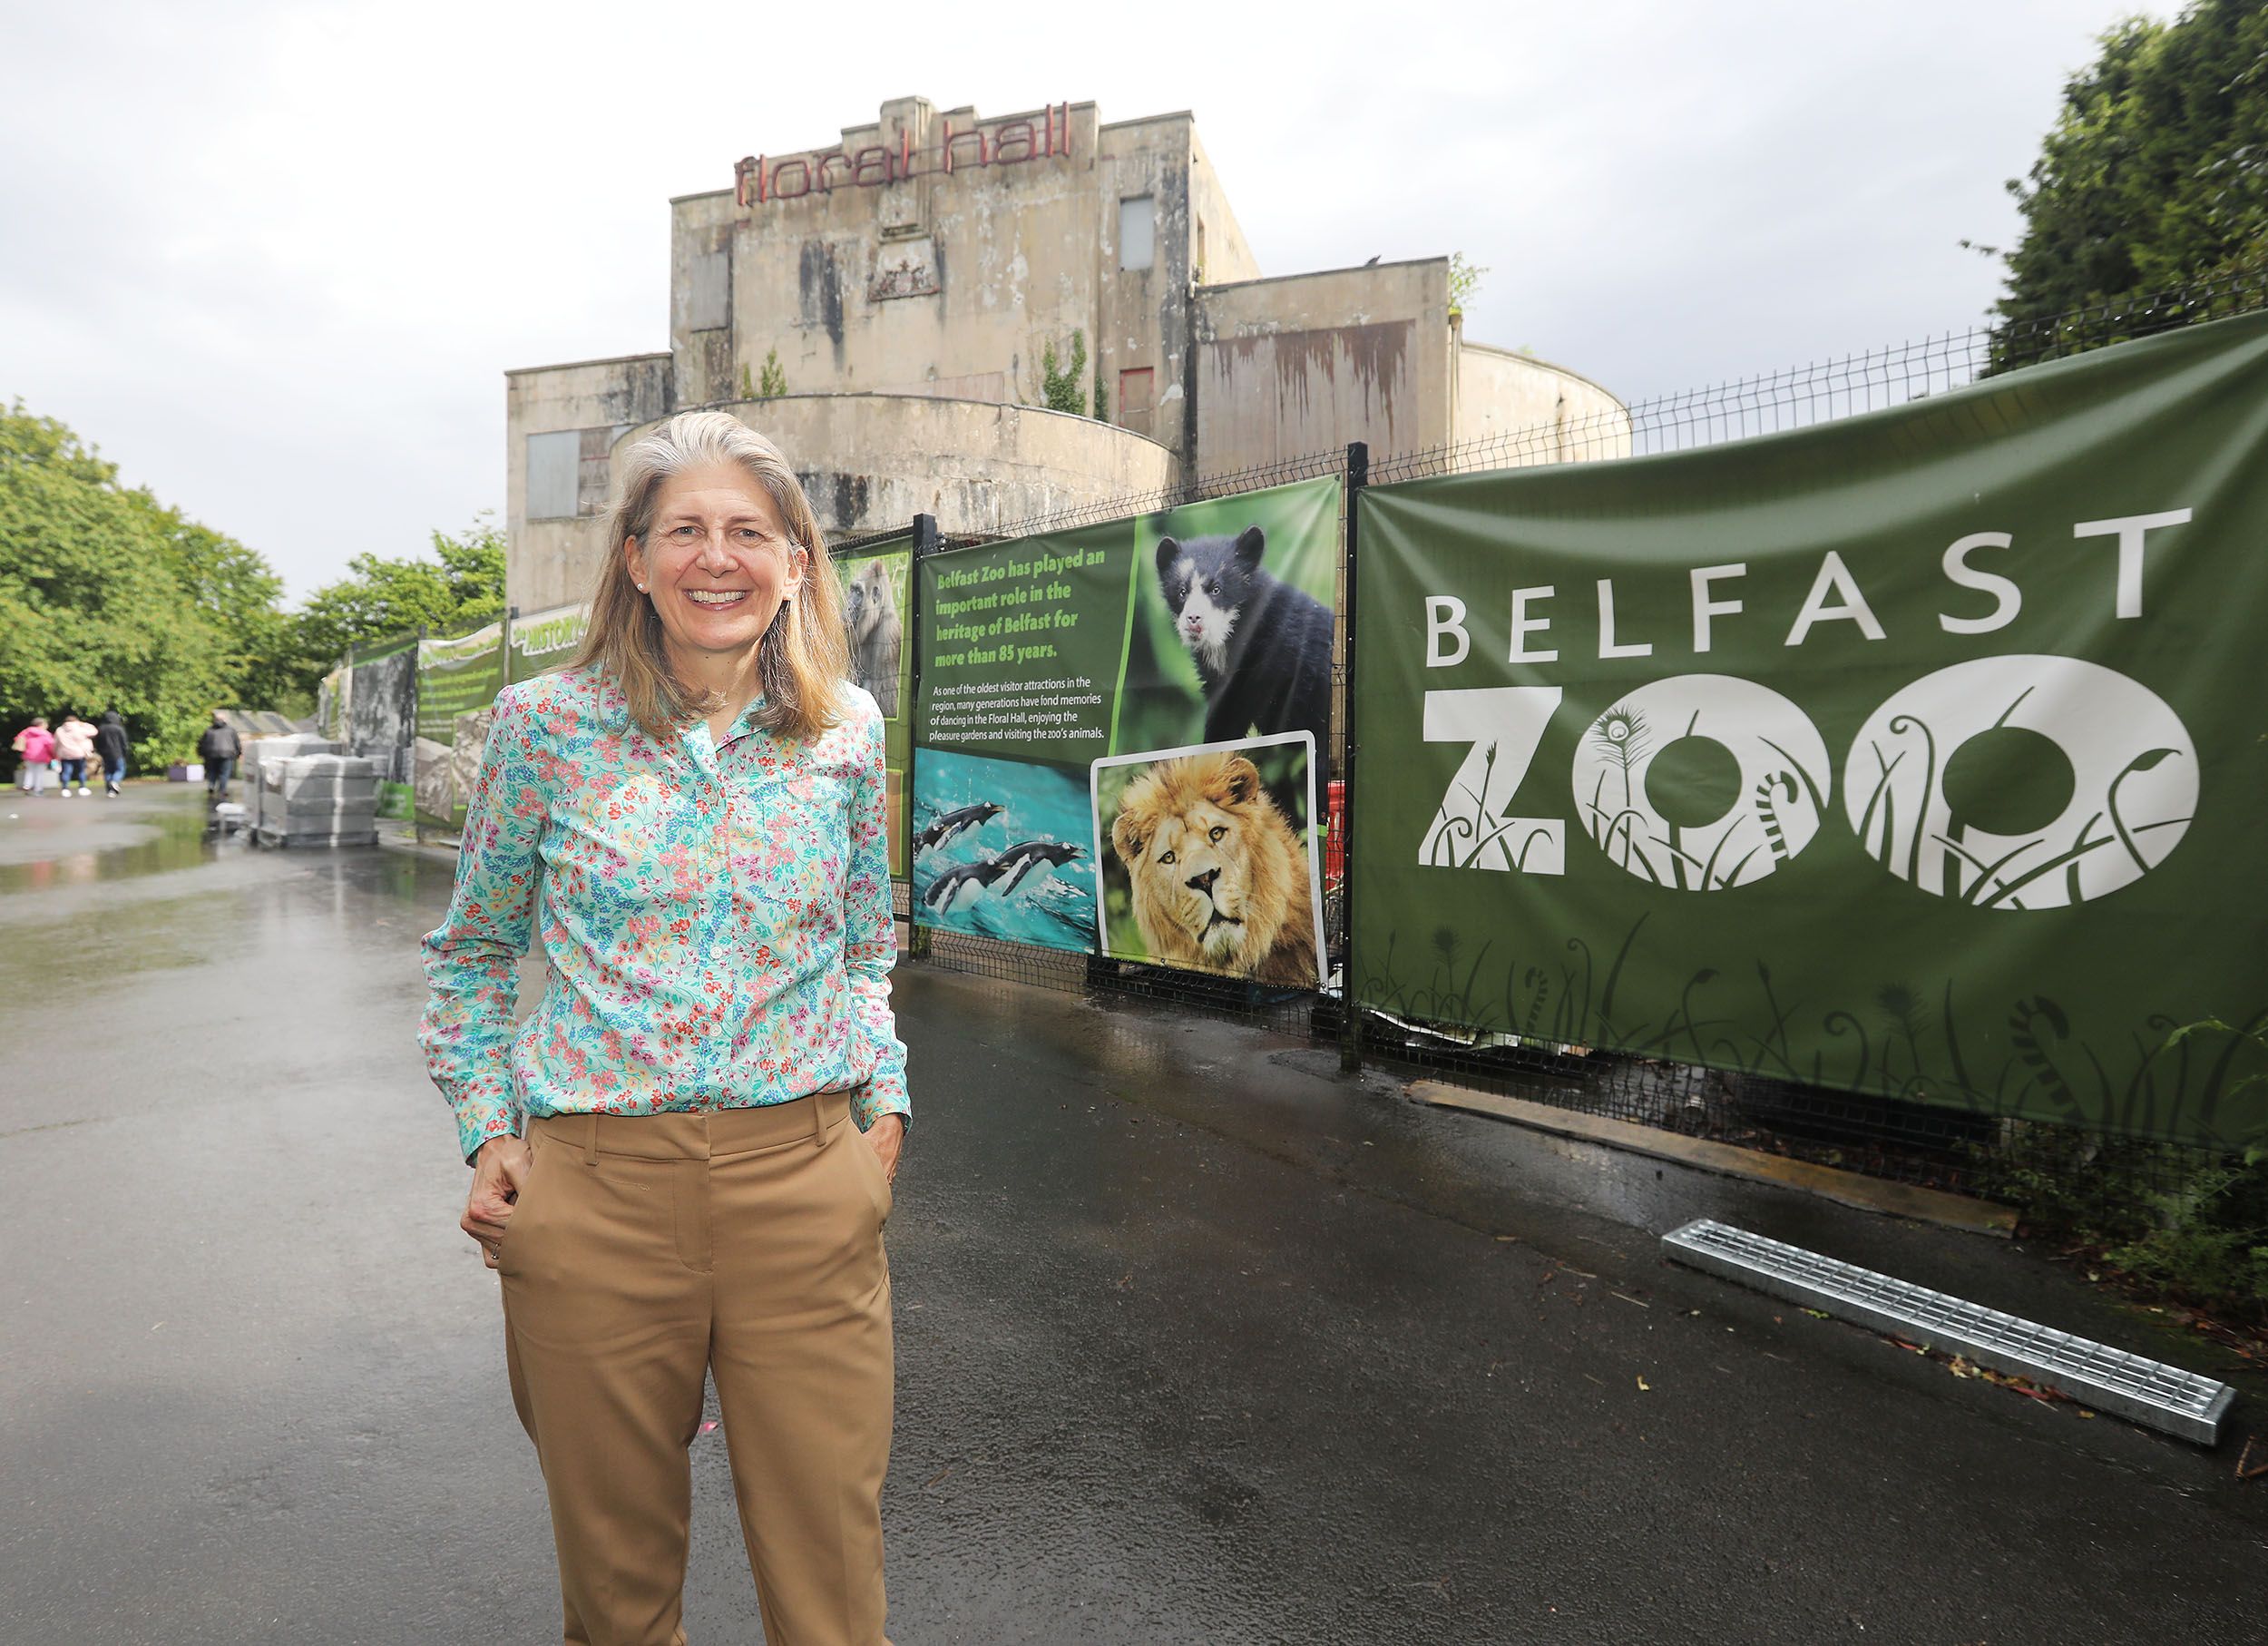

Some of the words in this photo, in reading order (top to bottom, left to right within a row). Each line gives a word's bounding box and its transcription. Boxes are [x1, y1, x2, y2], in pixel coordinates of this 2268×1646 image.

[734, 128, 908, 207] floral
[943, 101, 1070, 174] hall
[937, 568, 979, 590] Belfast
[982, 566, 1005, 583] Zoo
[1008, 560, 1031, 577] has
[1033, 548, 1084, 578] played
[1087, 551, 1105, 565] an
[935, 593, 997, 618] important
[1001, 586, 1026, 606] role
[1030, 585, 1042, 602] in
[1047, 581, 1071, 600] the
[1424, 507, 2193, 669] BELFAST
[936, 623, 986, 642] heritage
[988, 618, 1002, 635] of
[1004, 612, 1051, 633] Belfast
[1054, 610, 1078, 627] for
[934, 652, 964, 667] more
[968, 647, 996, 664] than
[999, 645, 1014, 661] 85
[1017, 643, 1057, 664] years.
[933, 686, 942, 696] As
[943, 687, 954, 695] one
[956, 685, 963, 694] of
[963, 684, 975, 694] the
[977, 682, 999, 693] oldest
[1000, 681, 1023, 692] visitor
[1024, 679, 1065, 691] attractions
[1067, 678, 1075, 688] in
[1076, 676, 1090, 688] the
[932, 701, 955, 712] region,
[957, 701, 974, 711] many
[976, 698, 1019, 710] generations
[1021, 696, 1039, 707] have
[1041, 694, 1059, 706] fond
[1061, 693, 1101, 705] memories
[929, 731, 960, 742] pleasure
[961, 730, 987, 742] gardens
[989, 730, 1002, 740] and
[1004, 729, 1031, 741] visiting
[1033, 729, 1046, 739] the
[1048, 728, 1067, 739] zoo's
[1068, 728, 1104, 739] animals.
[930, 716, 940, 725] of
[940, 715, 966, 727] dancing
[967, 715, 973, 723] in
[974, 714, 987, 724] the
[988, 713, 1009, 724] Floral
[1011, 712, 1027, 724] Hall,
[1028, 711, 1061, 725] enjoying
[1063, 711, 1078, 721] the
[1418, 653, 2201, 911] ZOO
